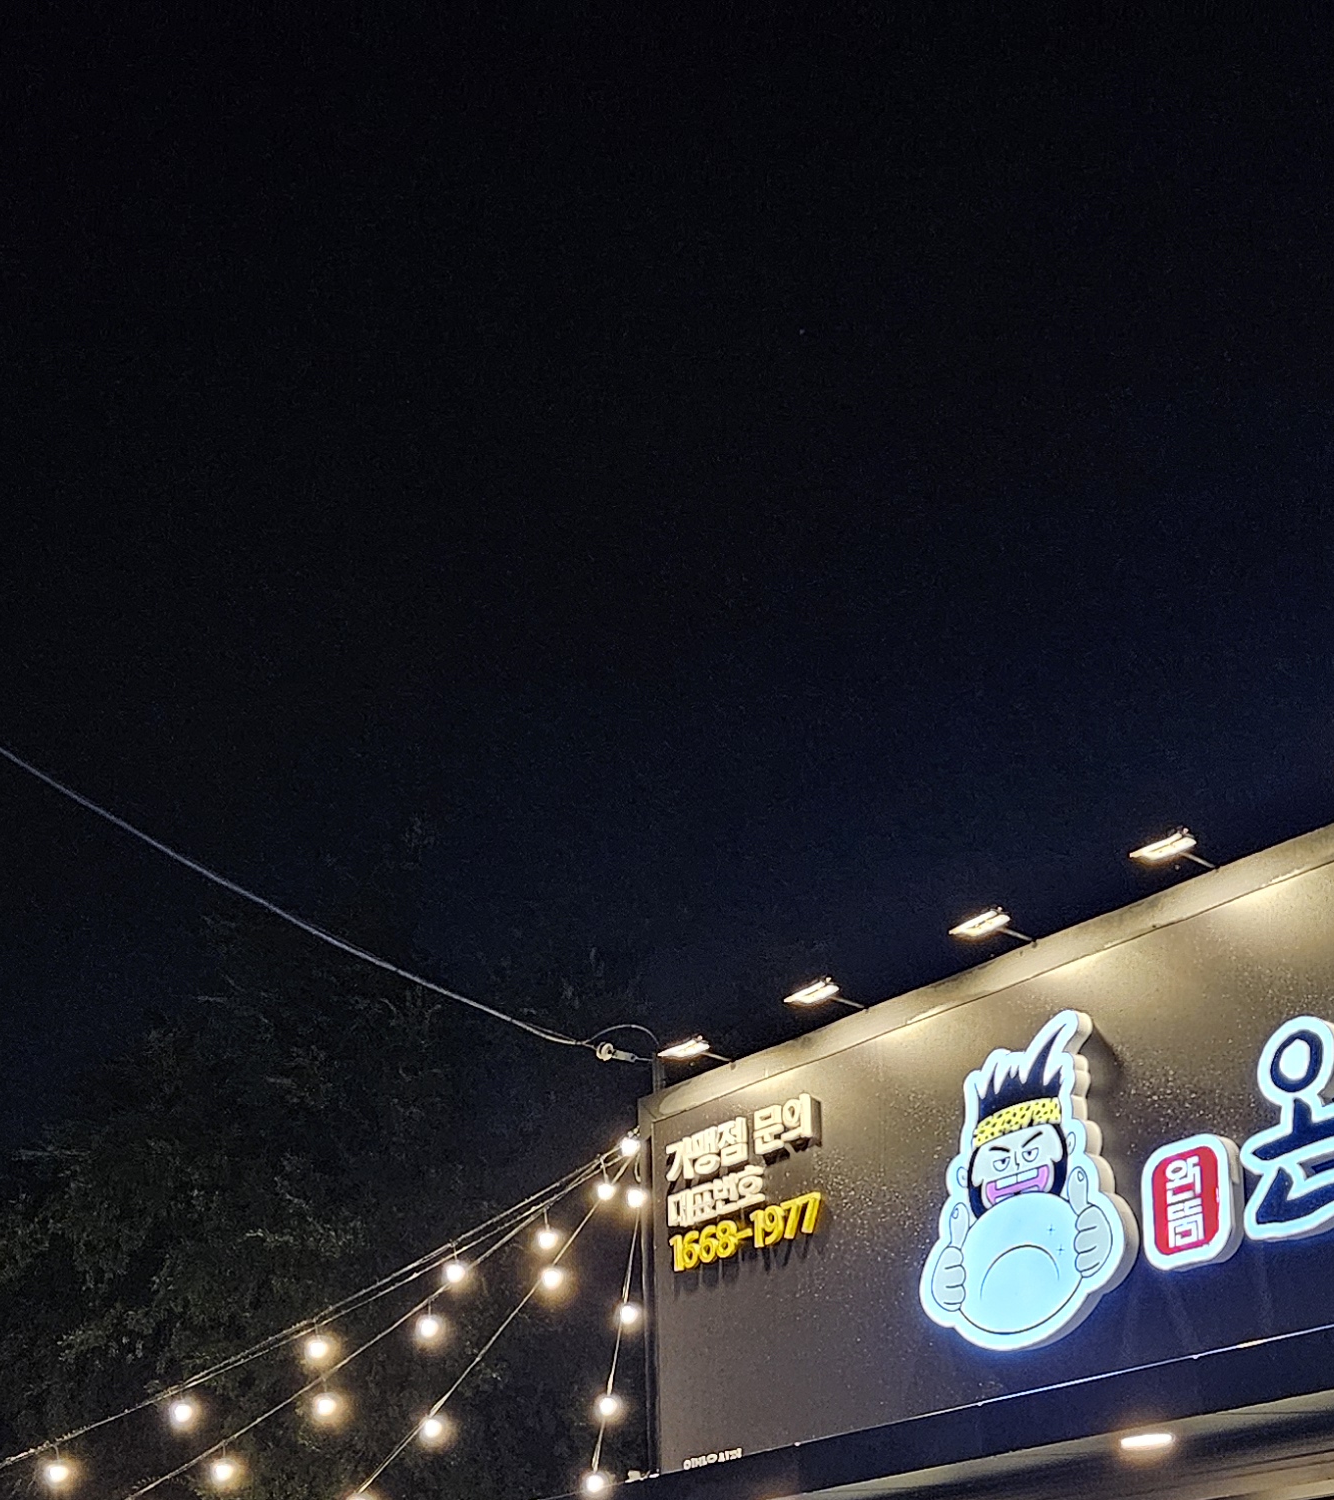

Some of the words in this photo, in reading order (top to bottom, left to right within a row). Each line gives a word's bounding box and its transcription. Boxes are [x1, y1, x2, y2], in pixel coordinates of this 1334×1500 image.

[666, 1116, 749, 1181] 가맹점
[754, 1093, 814, 1155] 문의
[668, 1165, 765, 1227] 대표번호
[669, 1191, 821, 1272] 1668-1977
